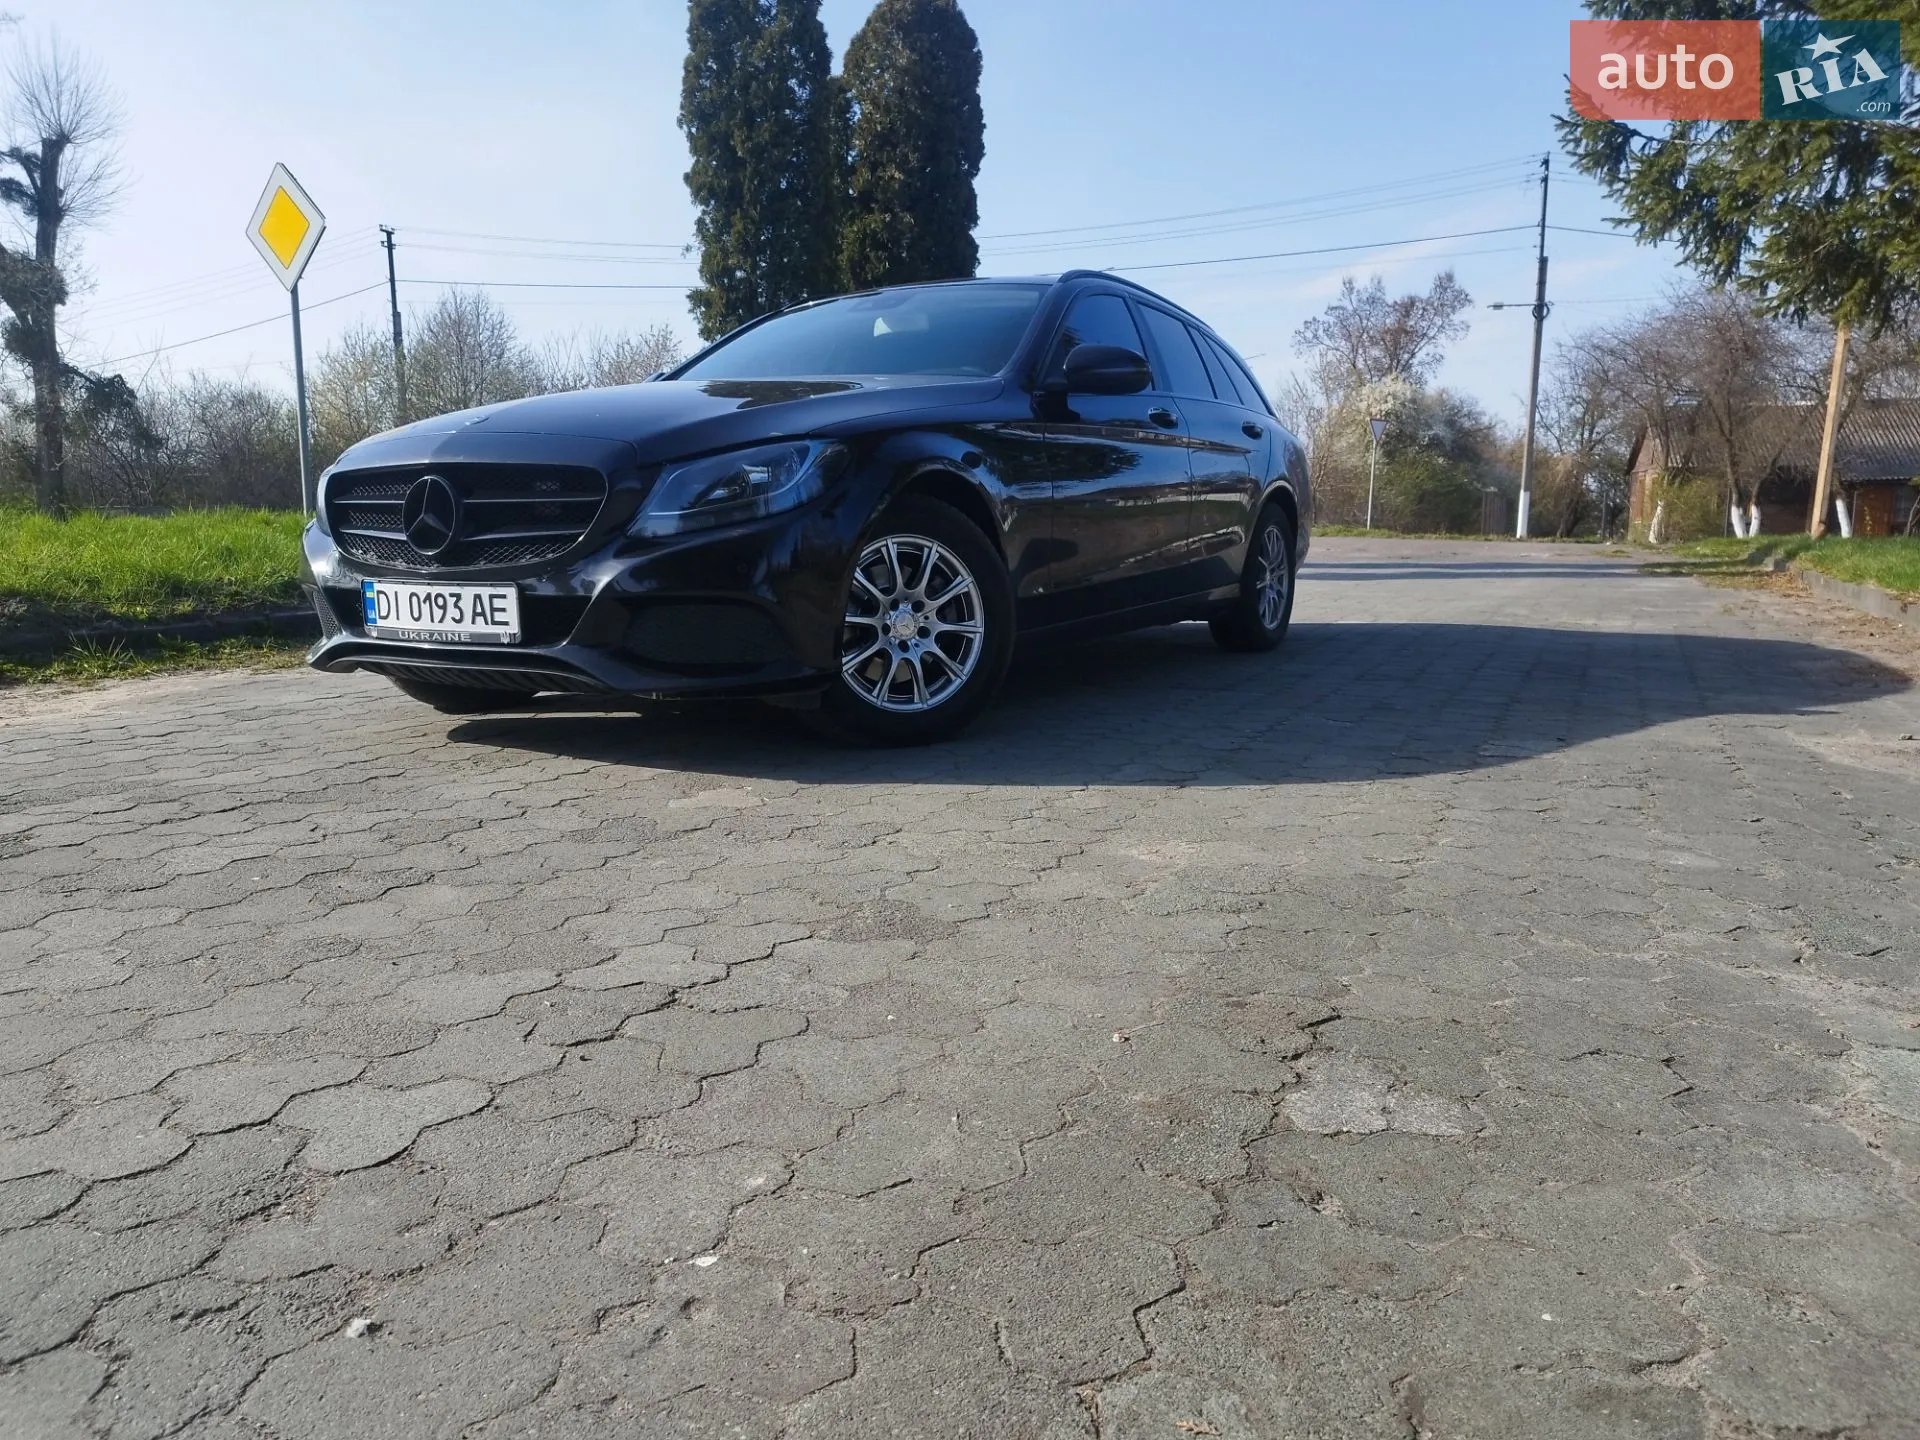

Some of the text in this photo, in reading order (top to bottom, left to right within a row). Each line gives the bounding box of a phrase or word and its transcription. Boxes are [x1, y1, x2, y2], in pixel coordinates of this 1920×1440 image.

[376, 590, 510, 626] DI 0193 AE
[398, 631, 472, 642] UKRAINE
